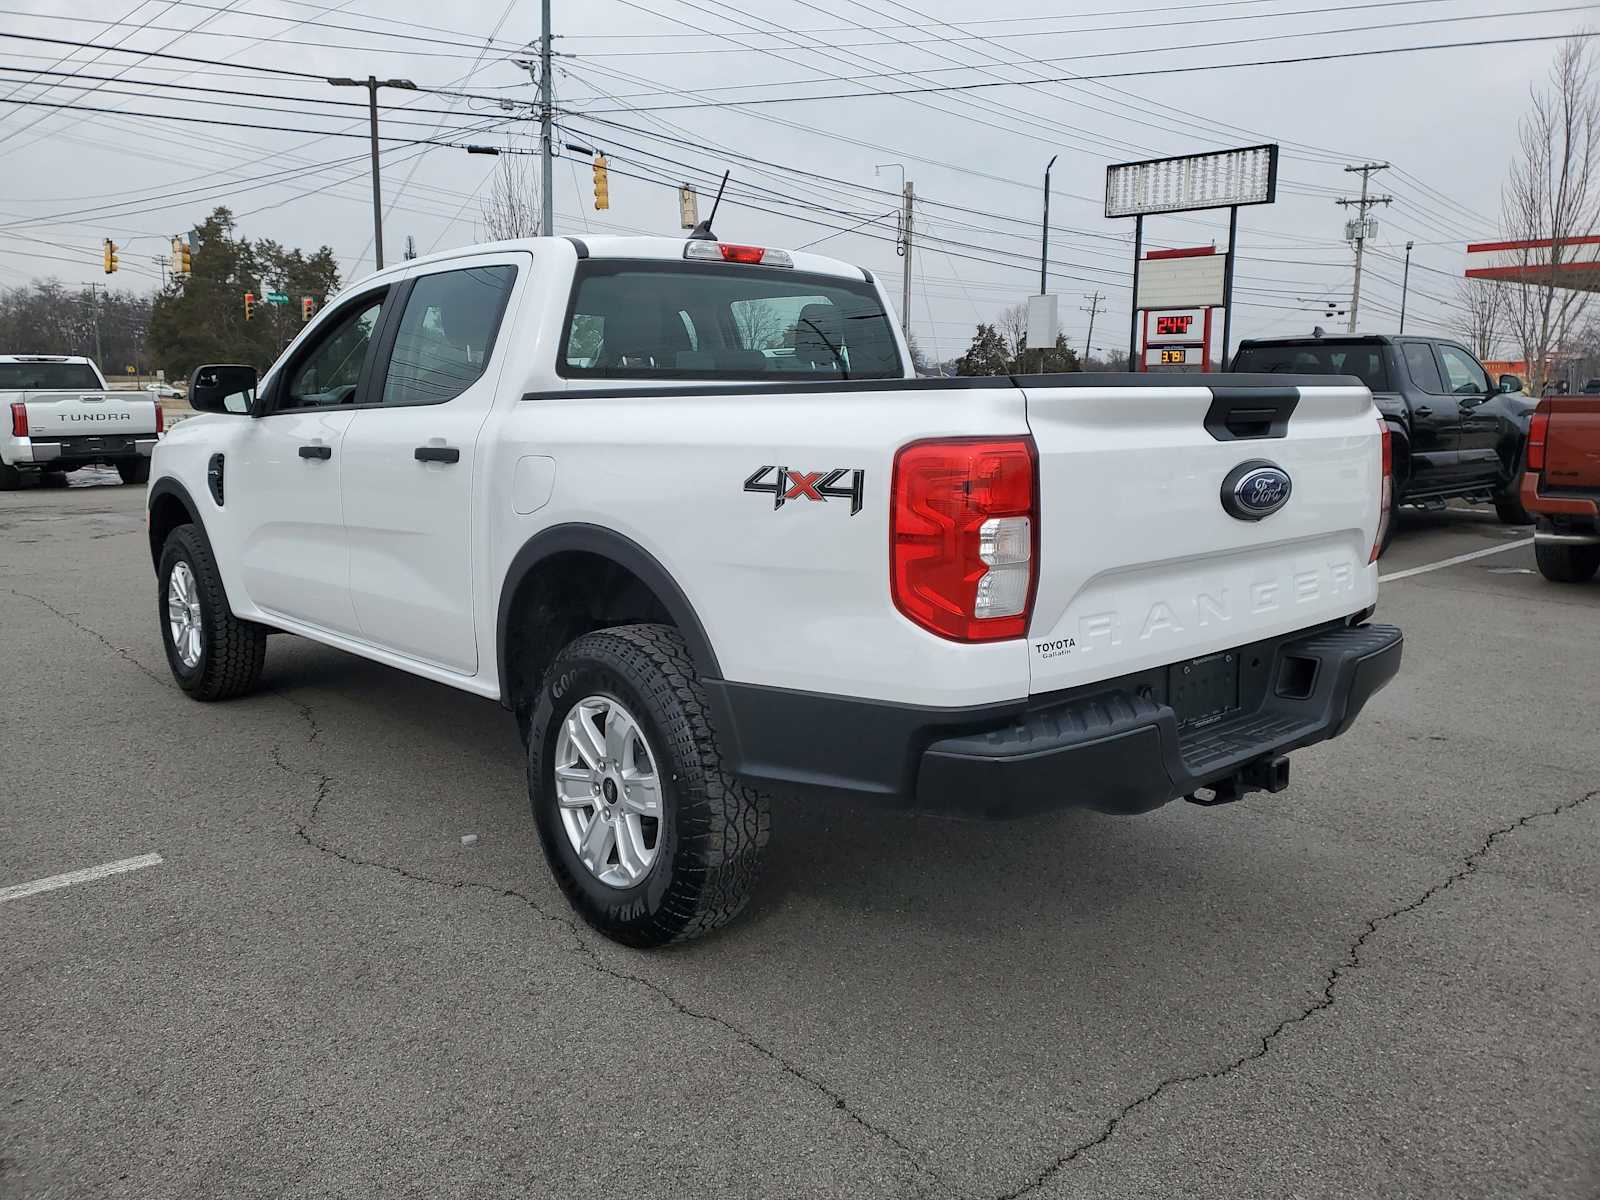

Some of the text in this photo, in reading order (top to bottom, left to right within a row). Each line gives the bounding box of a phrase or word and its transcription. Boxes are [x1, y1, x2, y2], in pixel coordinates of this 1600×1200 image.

[57, 413, 131, 422] TUNDRA
[1079, 561, 1355, 652] RANGER
[1035, 638, 1076, 653] TOYOTA
[1042, 649, 1072, 659] Gallatin
